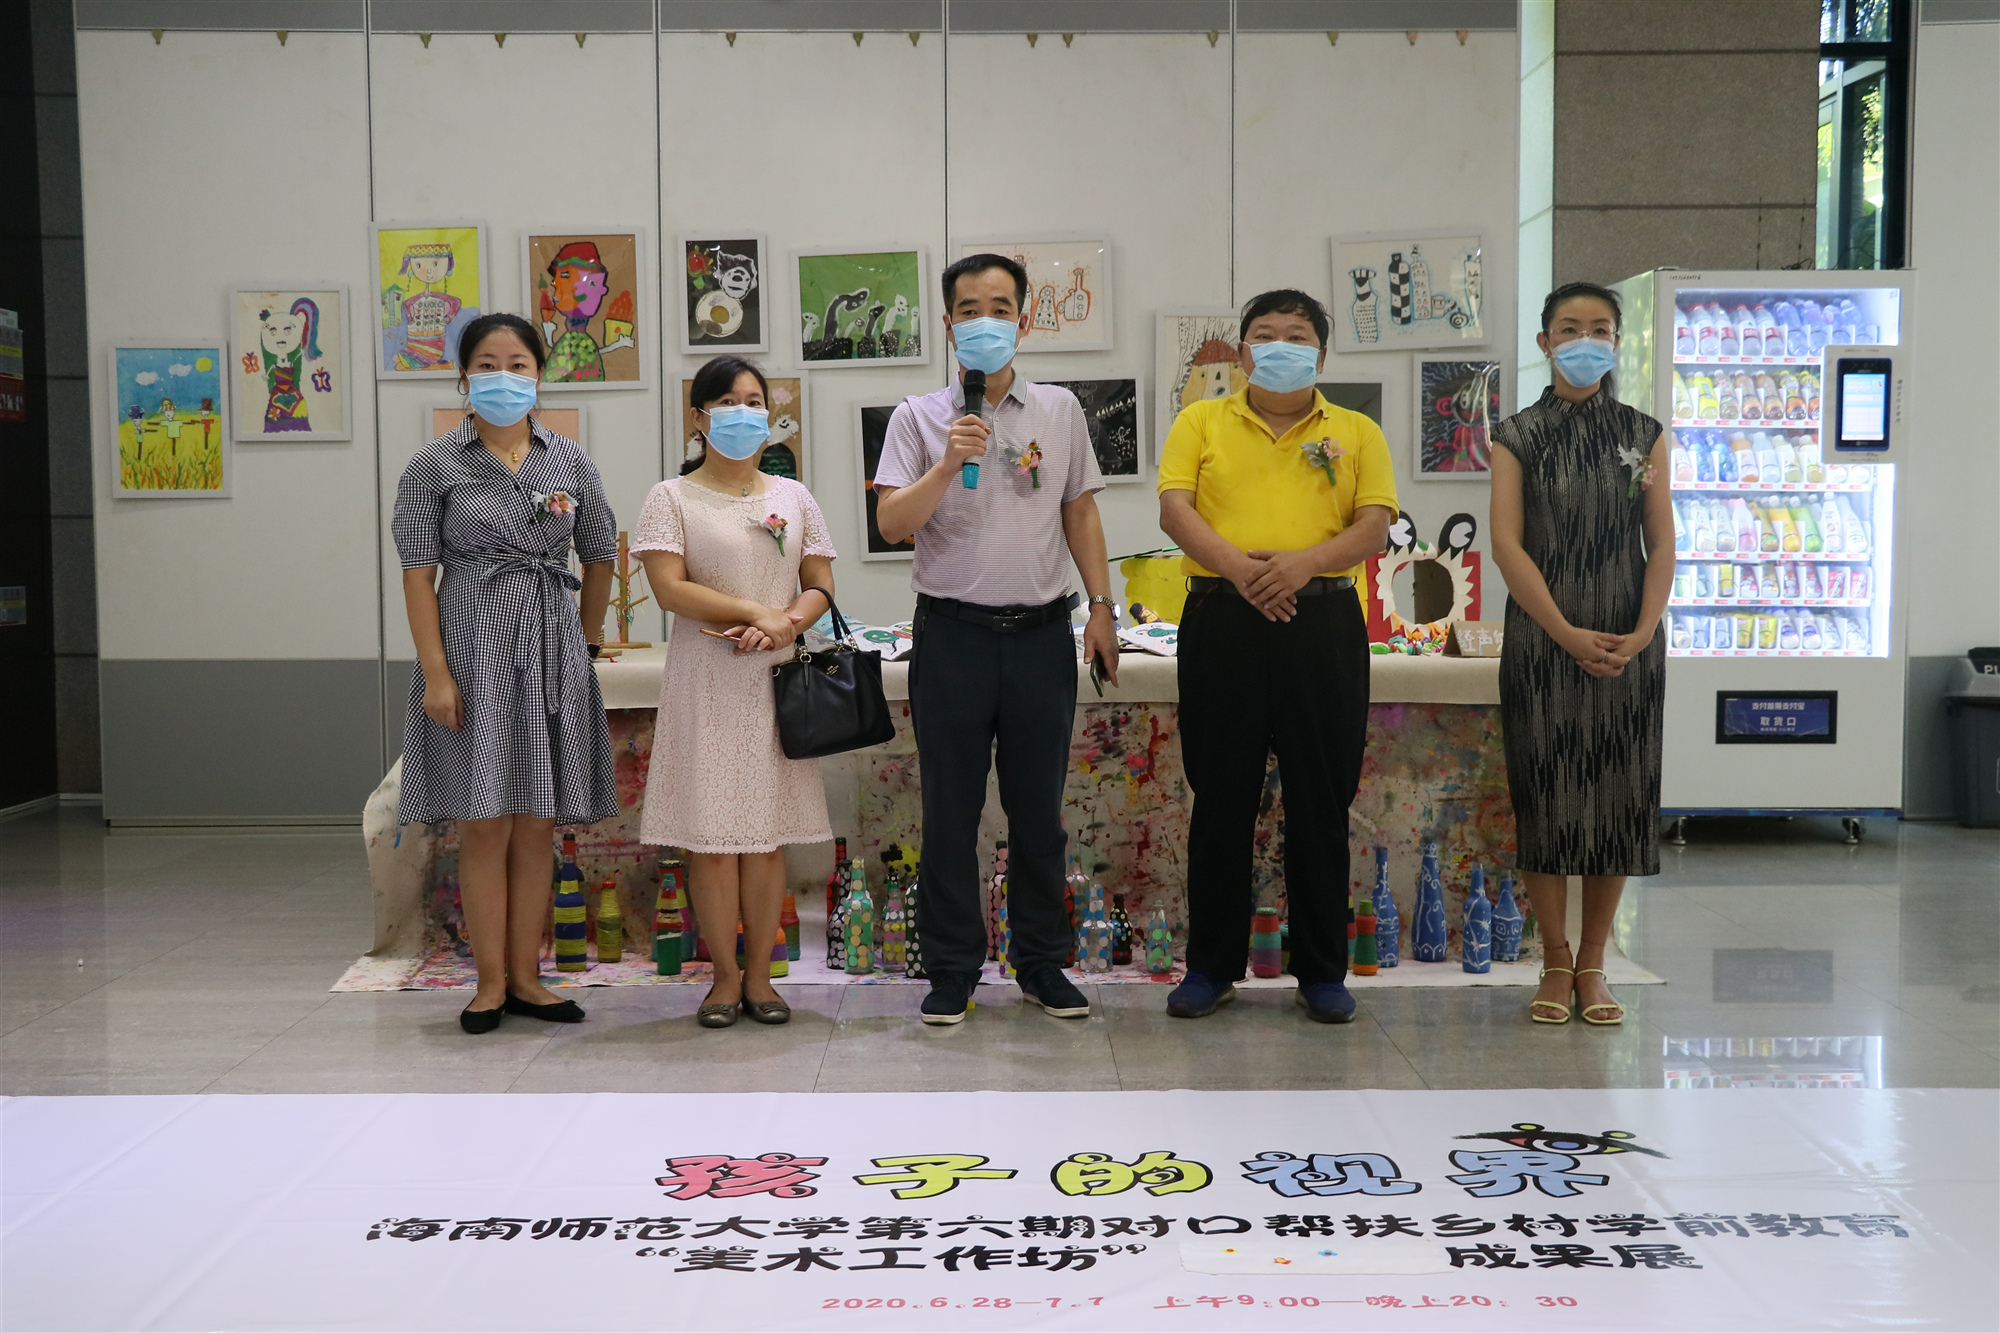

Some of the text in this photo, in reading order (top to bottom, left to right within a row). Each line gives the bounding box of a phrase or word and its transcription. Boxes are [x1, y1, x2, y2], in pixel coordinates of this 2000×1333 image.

[655, 1150, 1608, 1200] 孩子的视界
[366, 1213, 1909, 1241] 海南师范大学第六期对口帮扶乡村学前教育
[1445, 1243, 1704, 1270] 成果展
